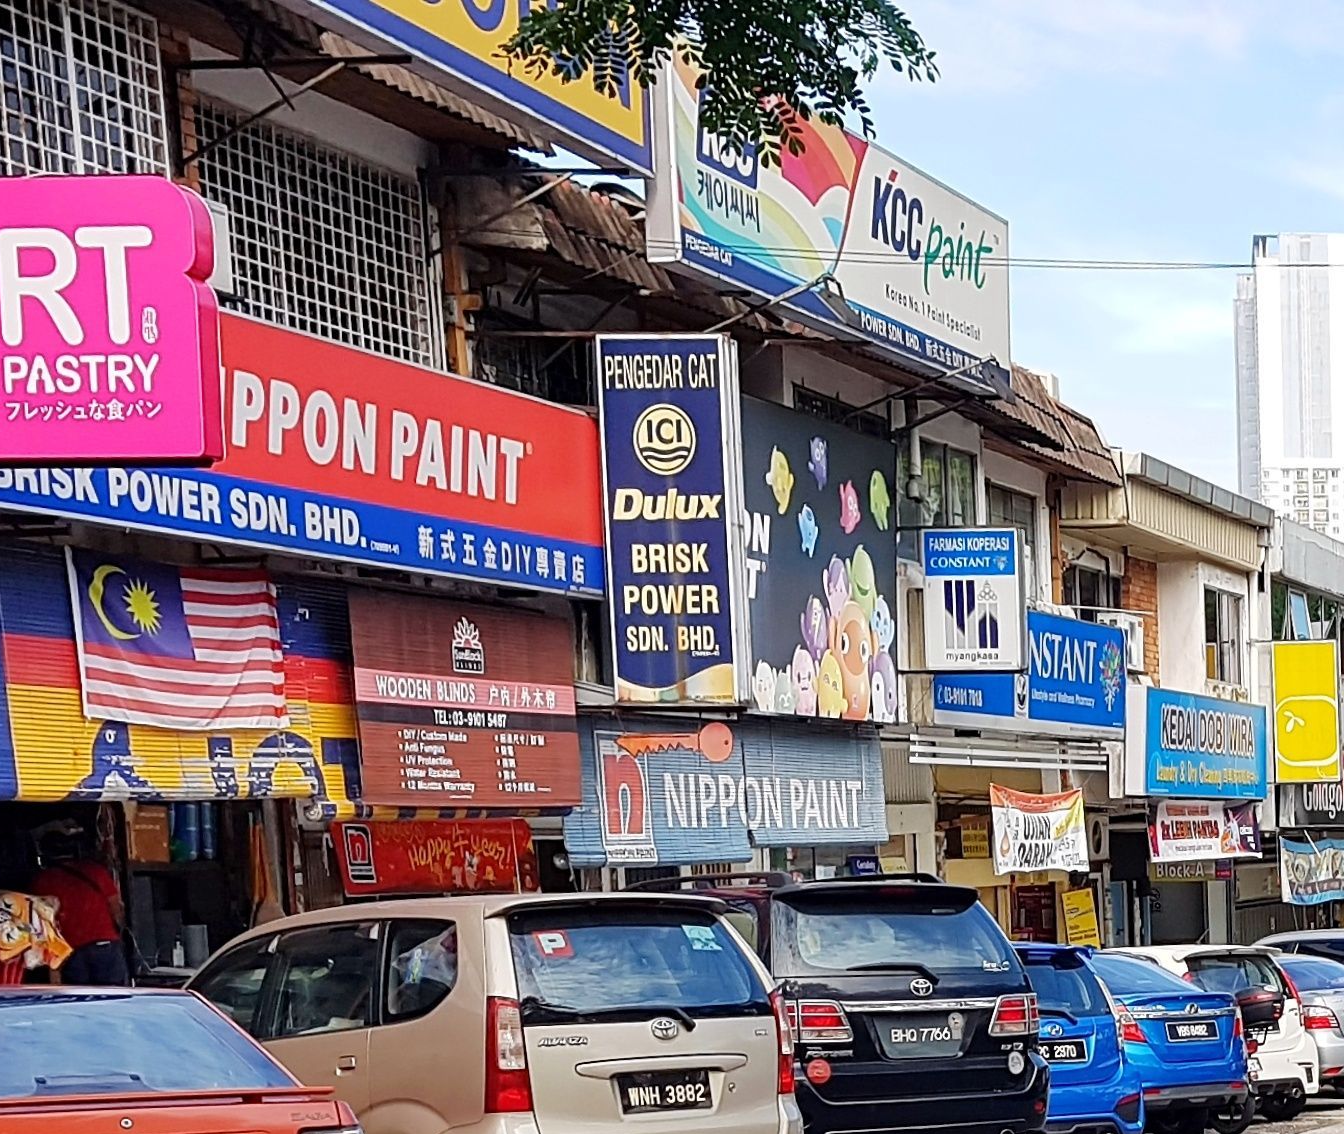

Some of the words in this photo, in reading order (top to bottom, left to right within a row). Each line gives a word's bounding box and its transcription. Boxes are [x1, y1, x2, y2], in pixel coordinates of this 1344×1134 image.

[871, 168, 923, 261] KCC
[923, 217, 994, 296] paint
[860, 310, 887, 337] POWER
[887, 322, 904, 344] SDN.
[885, 283, 907, 308] Korea
[908, 295, 921, 312] No.
[927, 303, 945, 324] Paint
[946, 313, 982, 341] Specialist
[2, 353, 160, 395] PASTRY
[604, 353, 684, 391] PENGEDAR
[687, 352, 717, 389] CAT
[4, 398, 163, 421] フレッシュな食パン
[221, 366, 377, 475] PPON
[390, 406, 524, 506] PAINT
[646, 416, 685, 445] ICI
[109, 467, 221, 525] POWER
[229, 485, 297, 537] SDN.
[303, 500, 367, 549] BHD.
[612, 487, 721, 522] Dulux
[630, 541, 710, 575] BRISK
[928, 537, 966, 552] FARMASI
[966, 536, 1010, 551] KOPERASI
[930, 556, 991, 568] CONSTANT
[622, 583, 721, 617] POWER
[626, 625, 669, 652] SDN.
[677, 625, 720, 652] BHD.
[946, 652, 999, 662] myangkasa
[375, 675, 432, 700] WOODEN
[436, 681, 476, 703] BLINDS
[1160, 703, 1197, 752] KEDAI
[1198, 709, 1227, 756] DOBI
[1228, 713, 1256, 760] WIRA
[662, 772, 783, 831] NIPPON
[787, 778, 862, 830] PAINT
[542, 932, 568, 956] P
[919, 1026, 952, 1042] 7766
[1055, 1045, 1077, 1058] 2970
[628, 1084, 660, 1105] WNH
[666, 1082, 706, 1102] 3882
